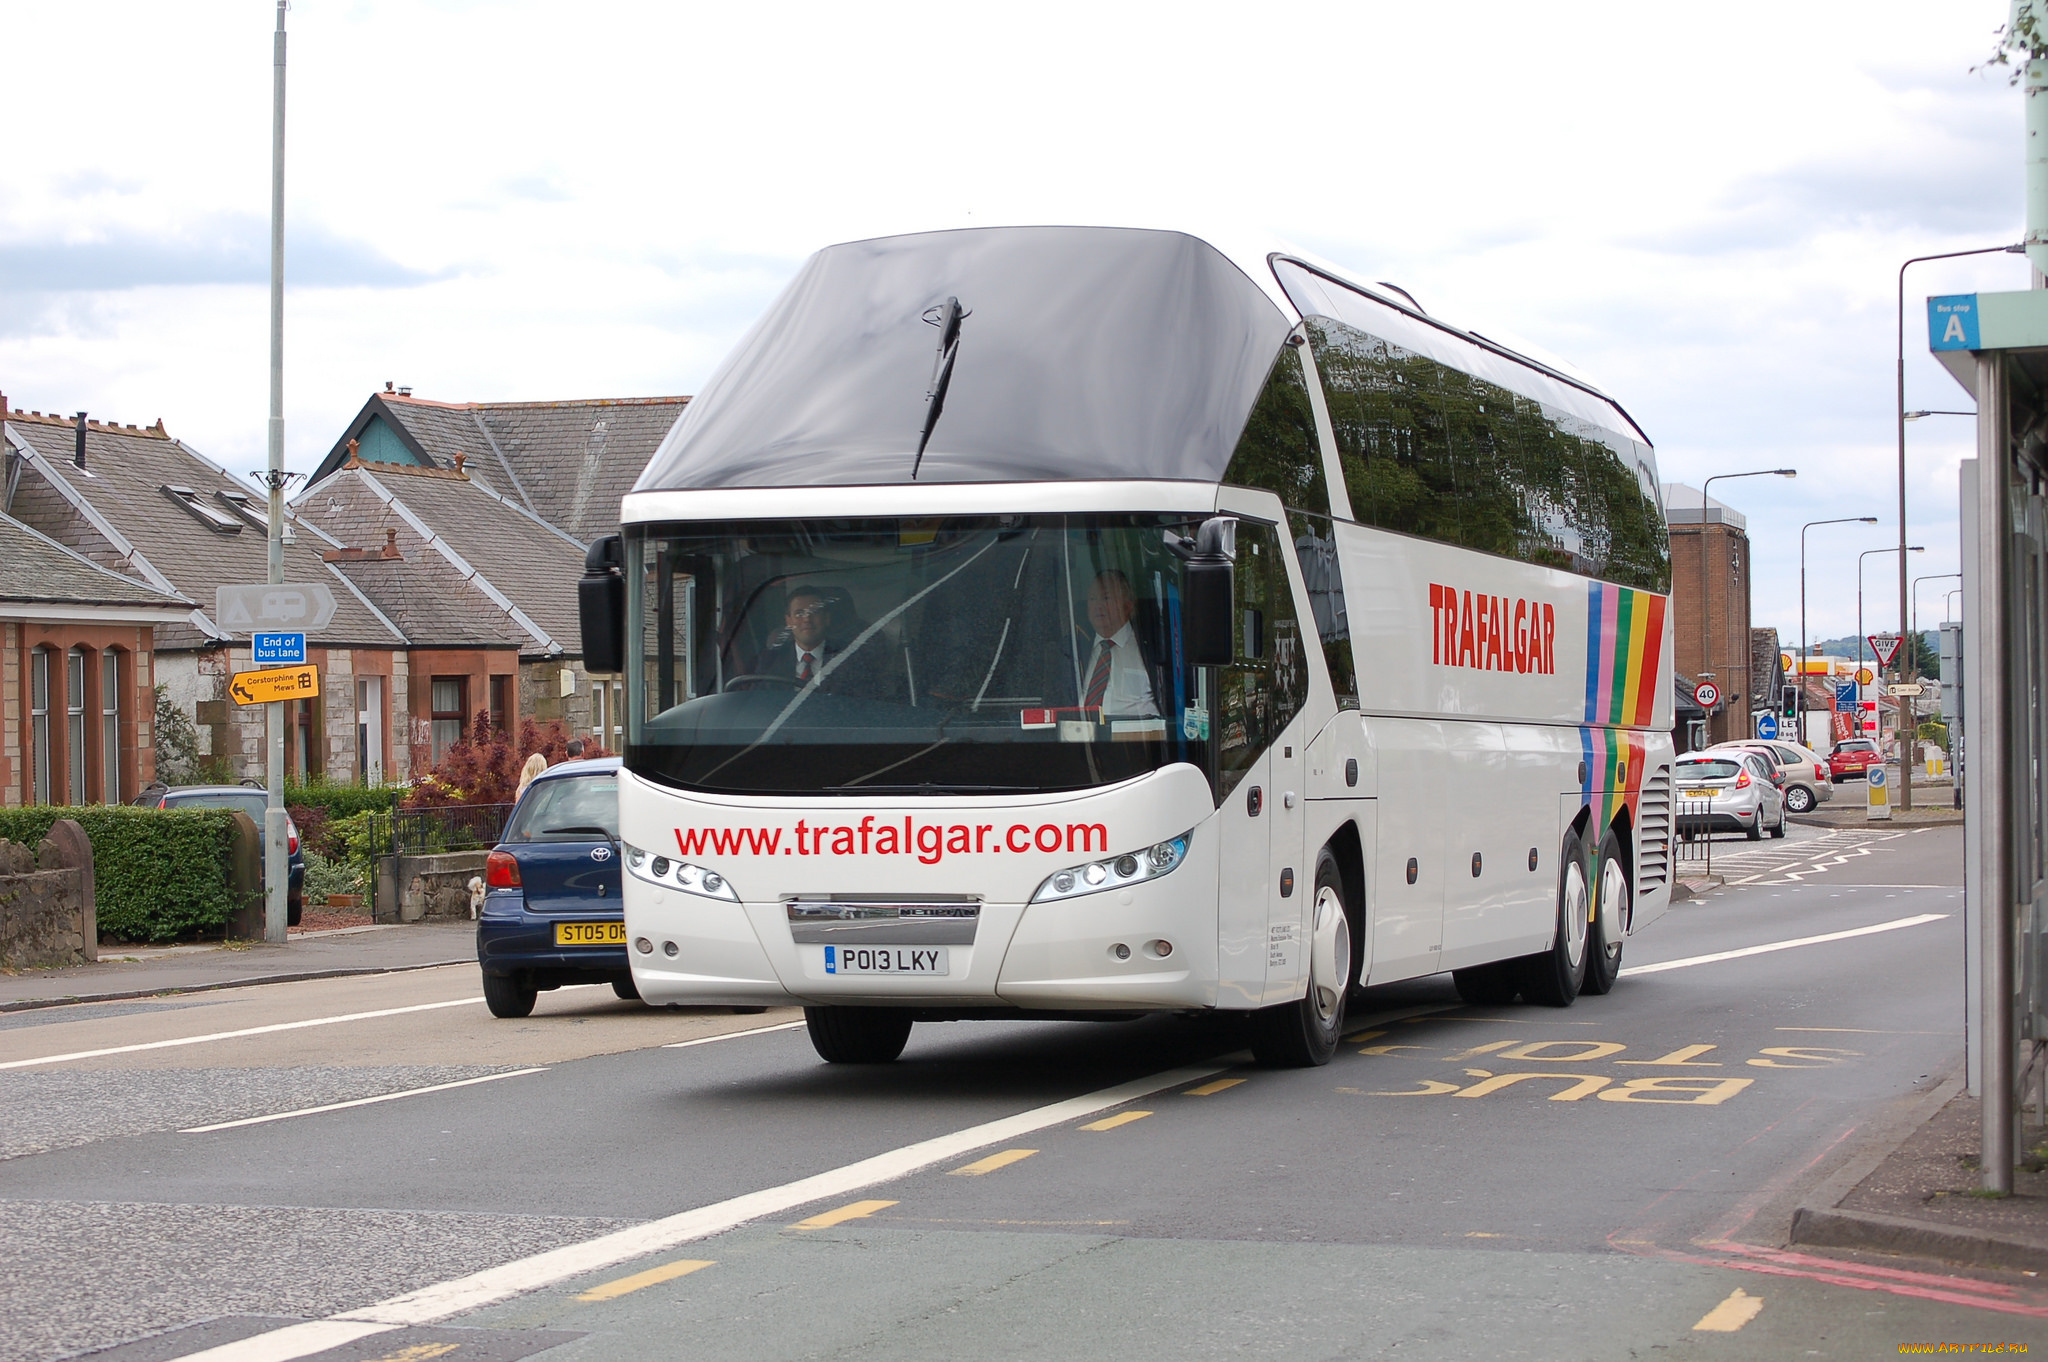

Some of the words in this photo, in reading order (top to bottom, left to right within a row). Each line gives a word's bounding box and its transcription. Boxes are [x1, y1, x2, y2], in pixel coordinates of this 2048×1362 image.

[1937, 304, 1951, 312] Bus
[1953, 304, 1970, 312] stop
[1942, 313, 1967, 343] A
[1428, 582, 1556, 675] TRAFALGAR
[263, 637, 282, 647] End
[284, 637, 296, 647] of
[1874, 640, 1895, 648] GIVE
[258, 648, 275, 657] bus
[278, 648, 300, 657] lane
[247, 674, 294, 685] Corstorphine
[1698, 689, 1715, 699] 40
[674, 815, 1109, 865] www.trafalgar.com
[564, 925, 604, 940] ST05
[609, 924, 627, 940] OR
[843, 949, 891, 970] PO13
[897, 950, 939, 971] LKY
[1358, 1040, 1865, 1069] STOP
[1334, 1068, 1755, 1106] BUS
